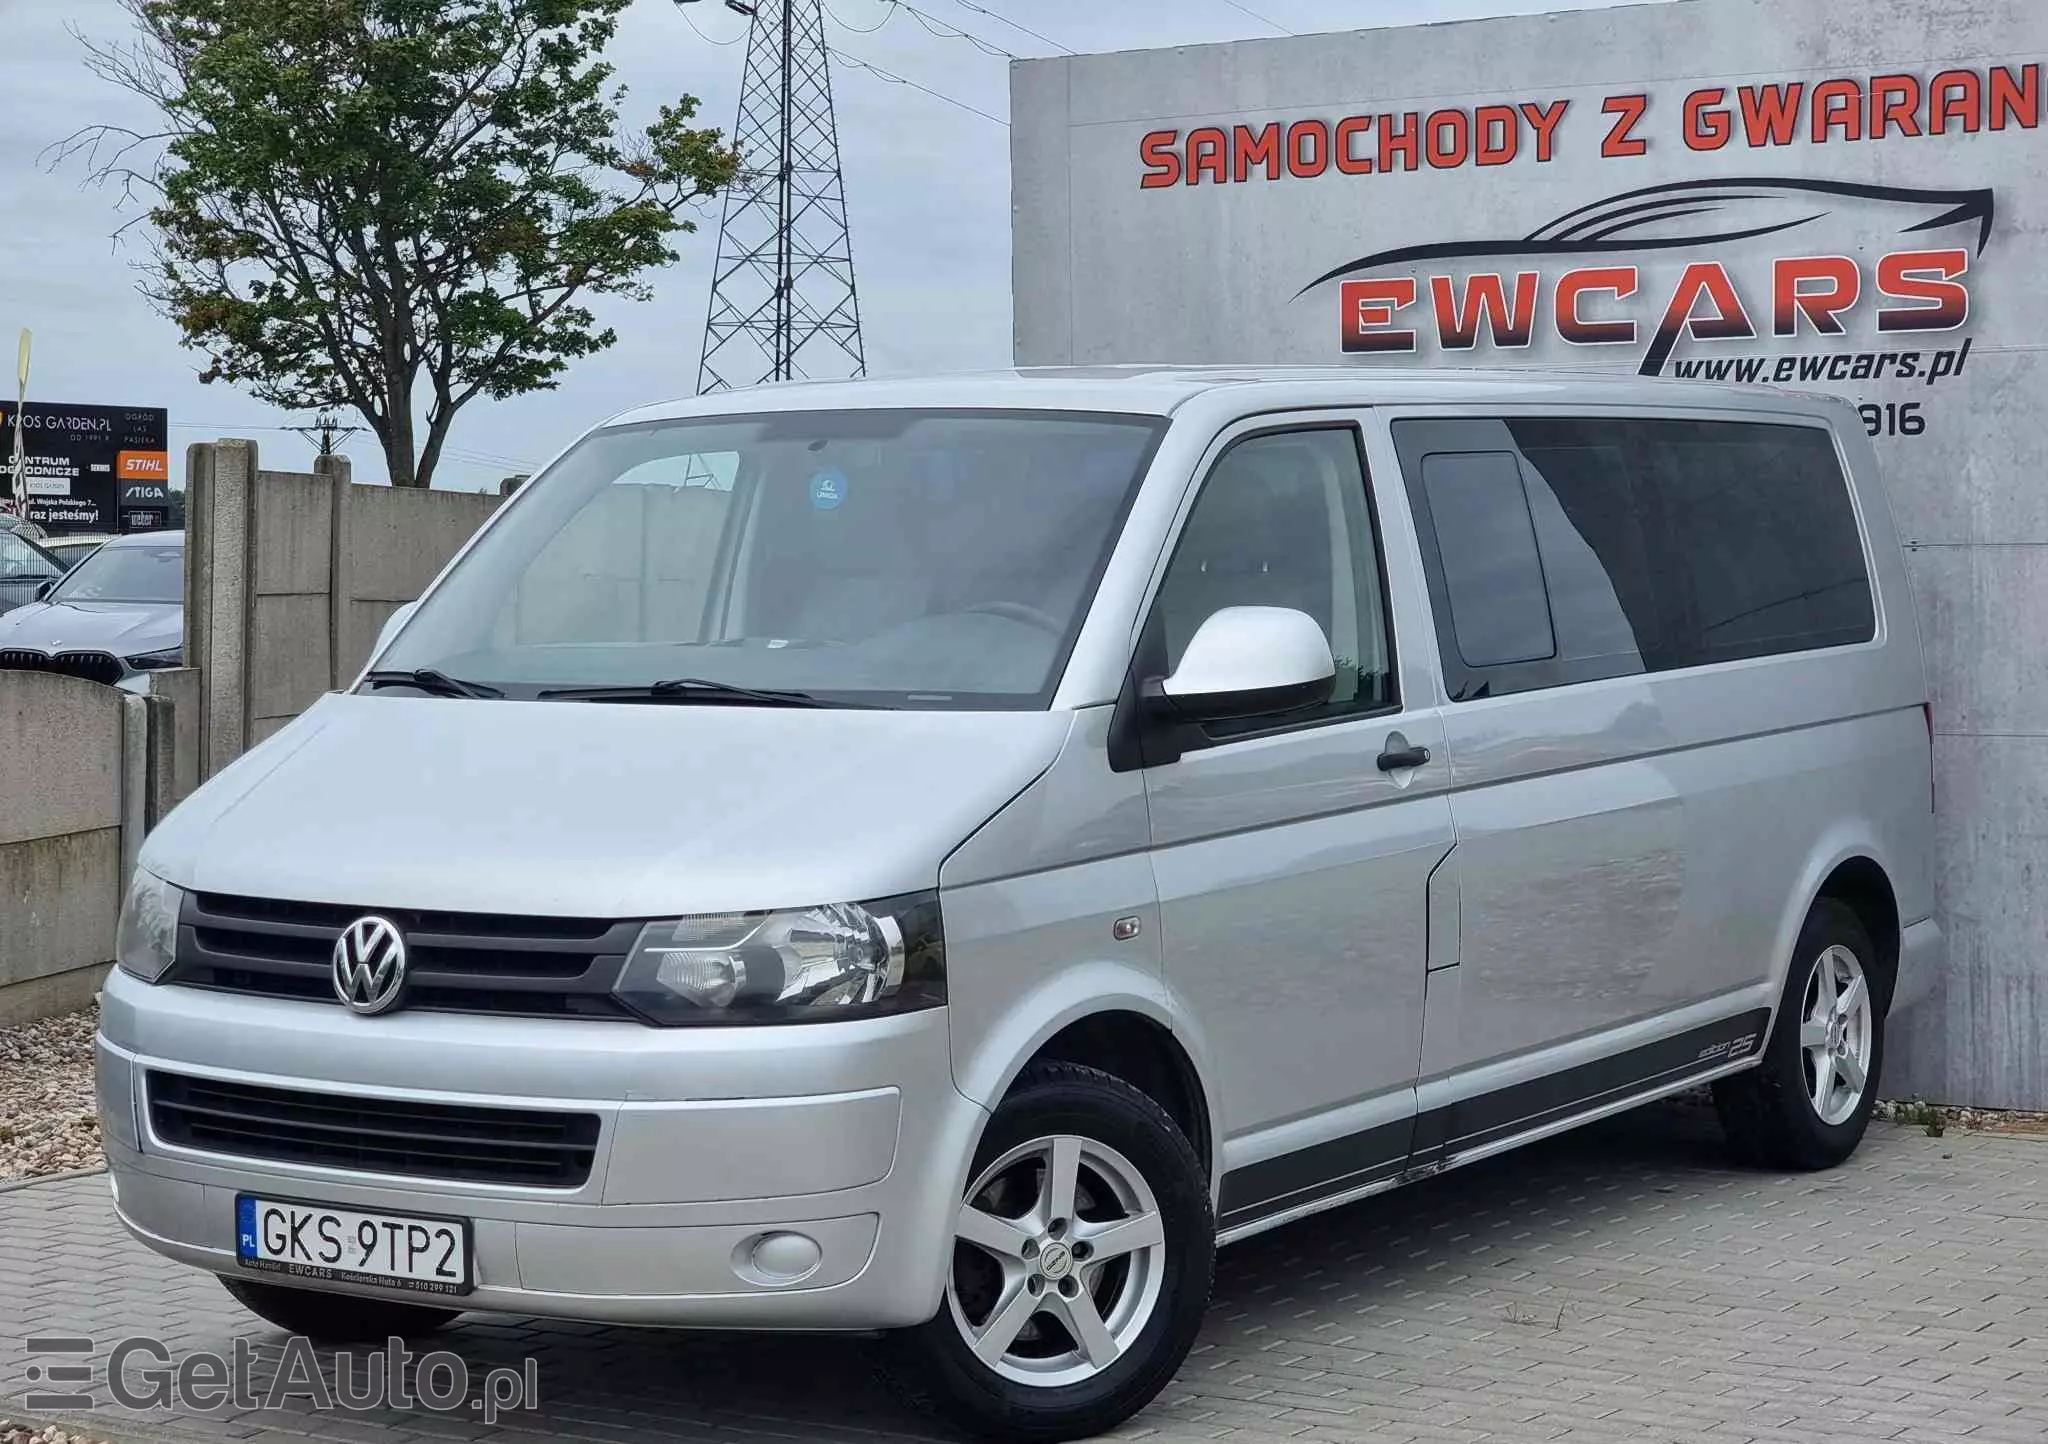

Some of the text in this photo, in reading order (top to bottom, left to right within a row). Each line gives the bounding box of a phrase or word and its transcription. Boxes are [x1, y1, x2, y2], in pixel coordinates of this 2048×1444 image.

[1140, 63, 2048, 189] SAMOCHODY Z GWARAN
[1339, 248, 1970, 376] EWCARS
[1674, 337, 1973, 386] www.ewcars.pl
[7, 414, 112, 431] KOS GARDEN.PL
[8, 456, 70, 466] CNTRUM
[126, 459, 164, 472] STIHL
[0, 465, 80, 477] OGODNICZE
[48, 508, 99, 524] jesteśmy!
[1728, 1033, 1758, 1058] 25
[242, 1234, 256, 1248] PL
[263, 1207, 458, 1278] GKS 9TP2
[289, 1263, 333, 1279] EWCARS
